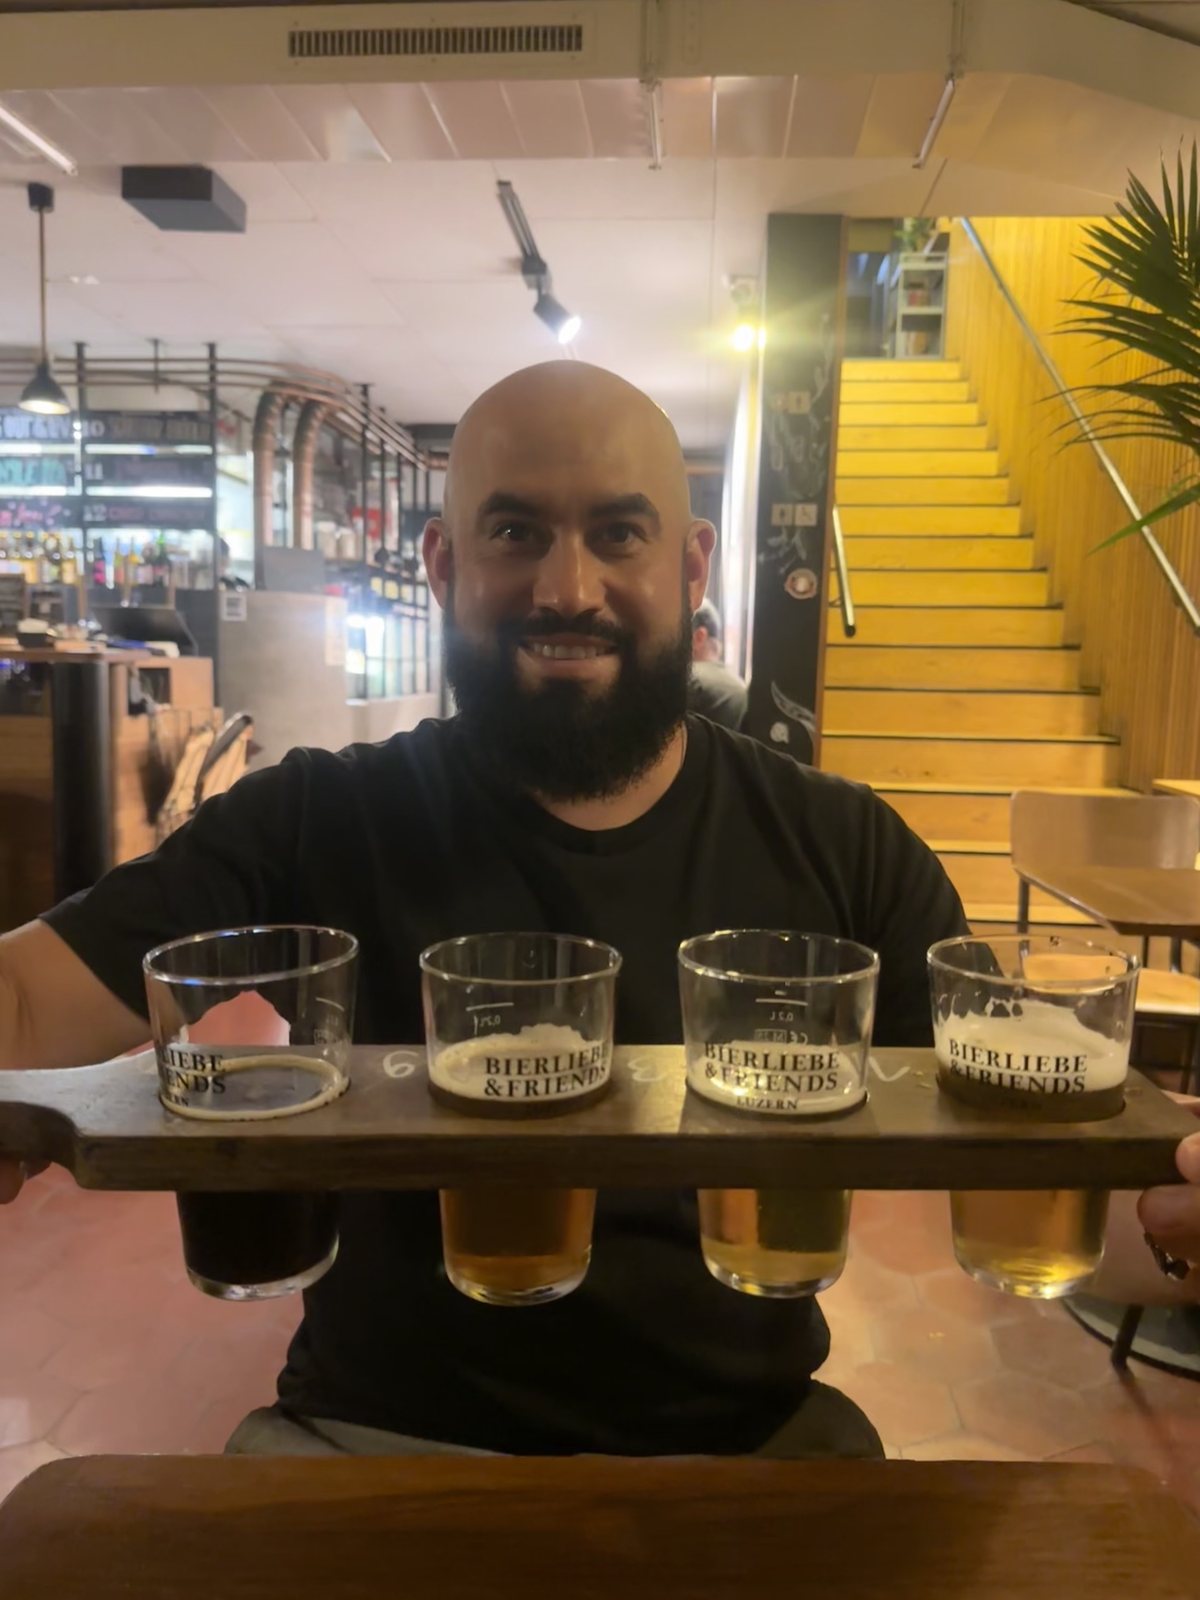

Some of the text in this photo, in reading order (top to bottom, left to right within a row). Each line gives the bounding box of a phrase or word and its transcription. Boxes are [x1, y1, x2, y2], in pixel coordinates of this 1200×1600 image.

[162, 1048, 225, 1073] LIEBE
[383, 1050, 418, 1078] 6
[704, 1041, 839, 1072] BIERLIEBE
[949, 1038, 1087, 1073] BIERLIEBE
[737, 1096, 799, 1111] LUZERN
